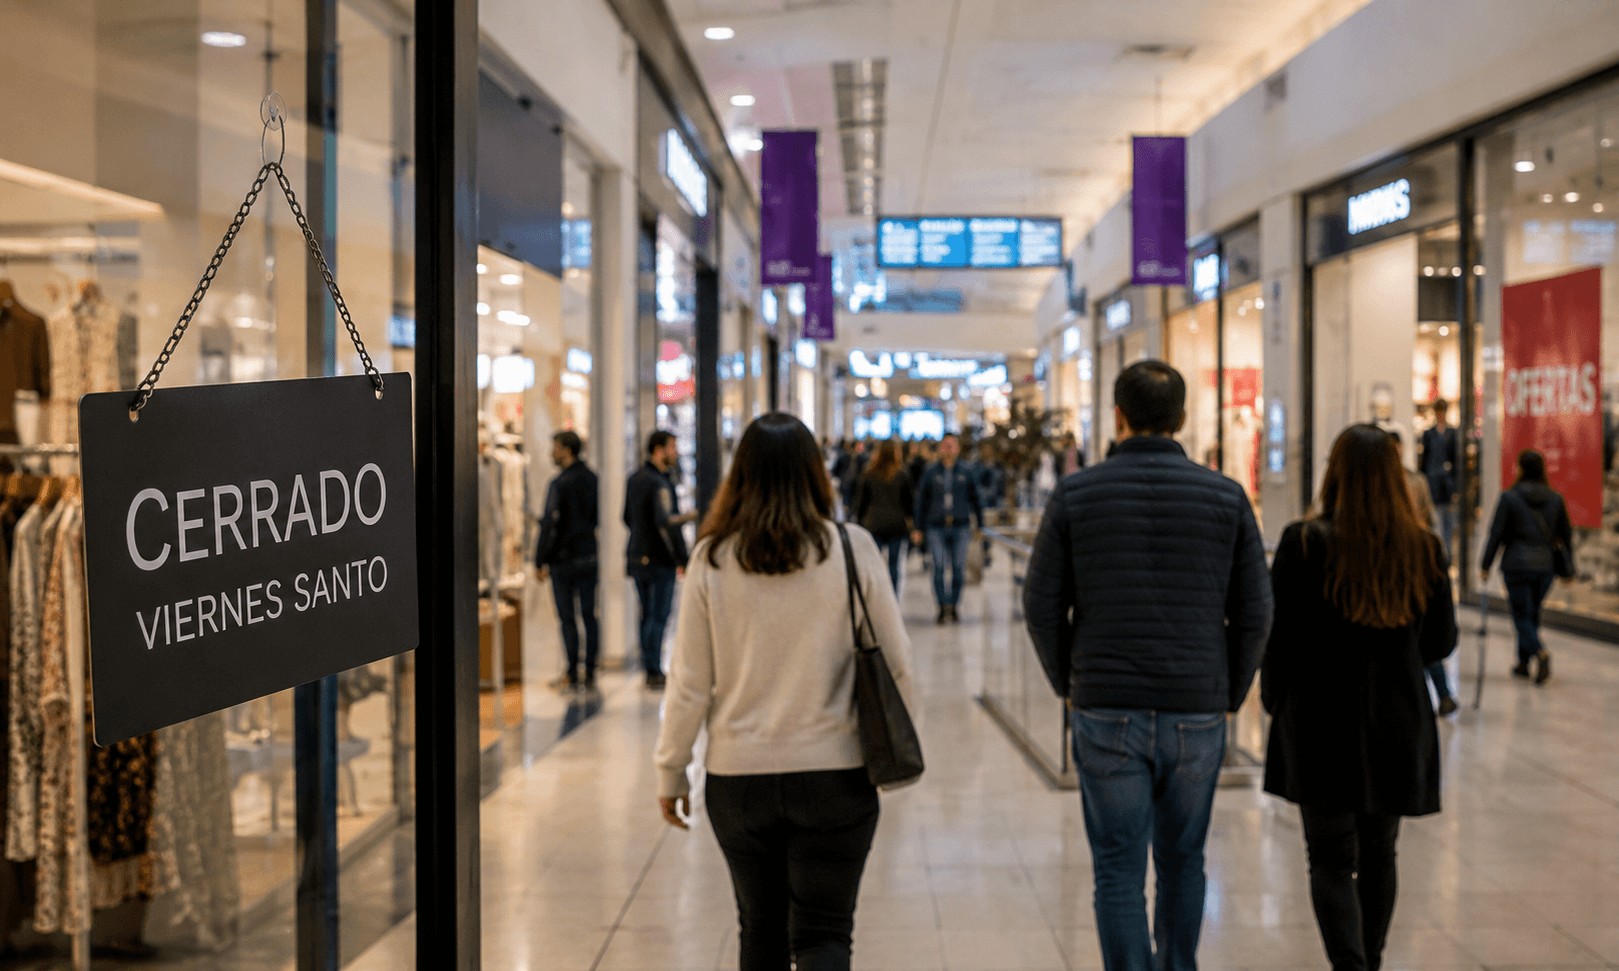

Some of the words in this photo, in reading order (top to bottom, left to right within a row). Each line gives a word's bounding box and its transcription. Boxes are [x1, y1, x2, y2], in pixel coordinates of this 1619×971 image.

[125, 462, 387, 571] CERRADO
[135, 579, 283, 650] VIERNES
[294, 555, 388, 612] SANTO
